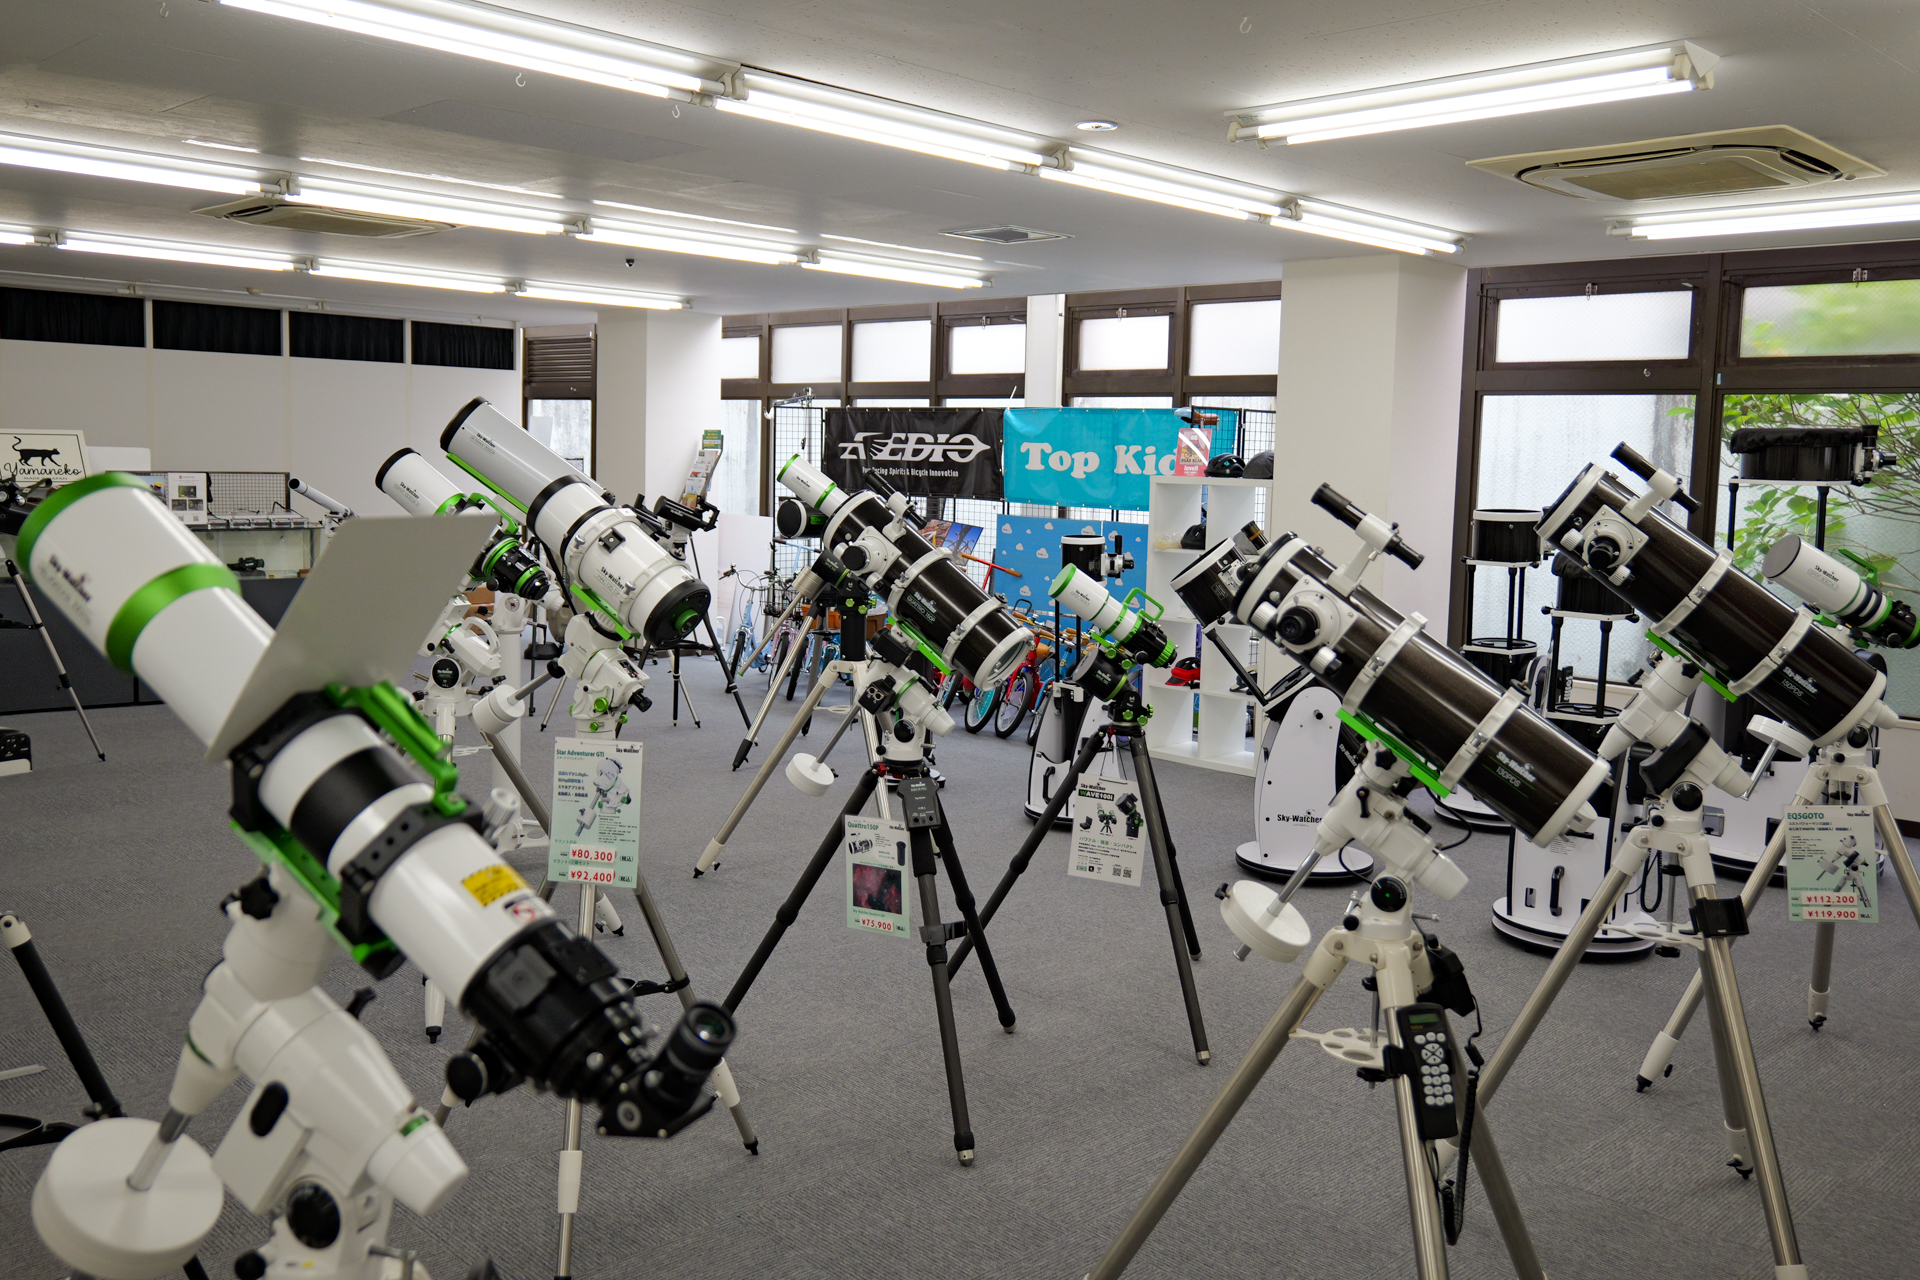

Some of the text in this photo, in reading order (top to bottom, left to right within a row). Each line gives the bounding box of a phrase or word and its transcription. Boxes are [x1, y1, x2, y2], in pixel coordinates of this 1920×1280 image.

[1020, 442, 1100, 479] Top
[4, 462, 82, 476] Yamaneko
[911, 468, 928, 477] Bicycle
[929, 469, 959, 477] Innovation
[914, 591, 937, 613] Sky-Watcher
[1783, 666, 1818, 694] Sky-Watcher
[1782, 679, 1804, 697] 150PDS
[1496, 751, 1536, 782] Sky-Watcher
[1496, 766, 1521, 787] 130PDS
[1277, 814, 1322, 823] Sky-Watcher
[1787, 812, 1824, 820] EQ5GOTO
[571, 849, 613, 862] ¥80,300
[570, 870, 612, 882] ¥92,400
[1807, 895, 1855, 904] ¥112,200
[1808, 910, 1856, 918] ¥119,900
[862, 919, 892, 931] ¥75,900
